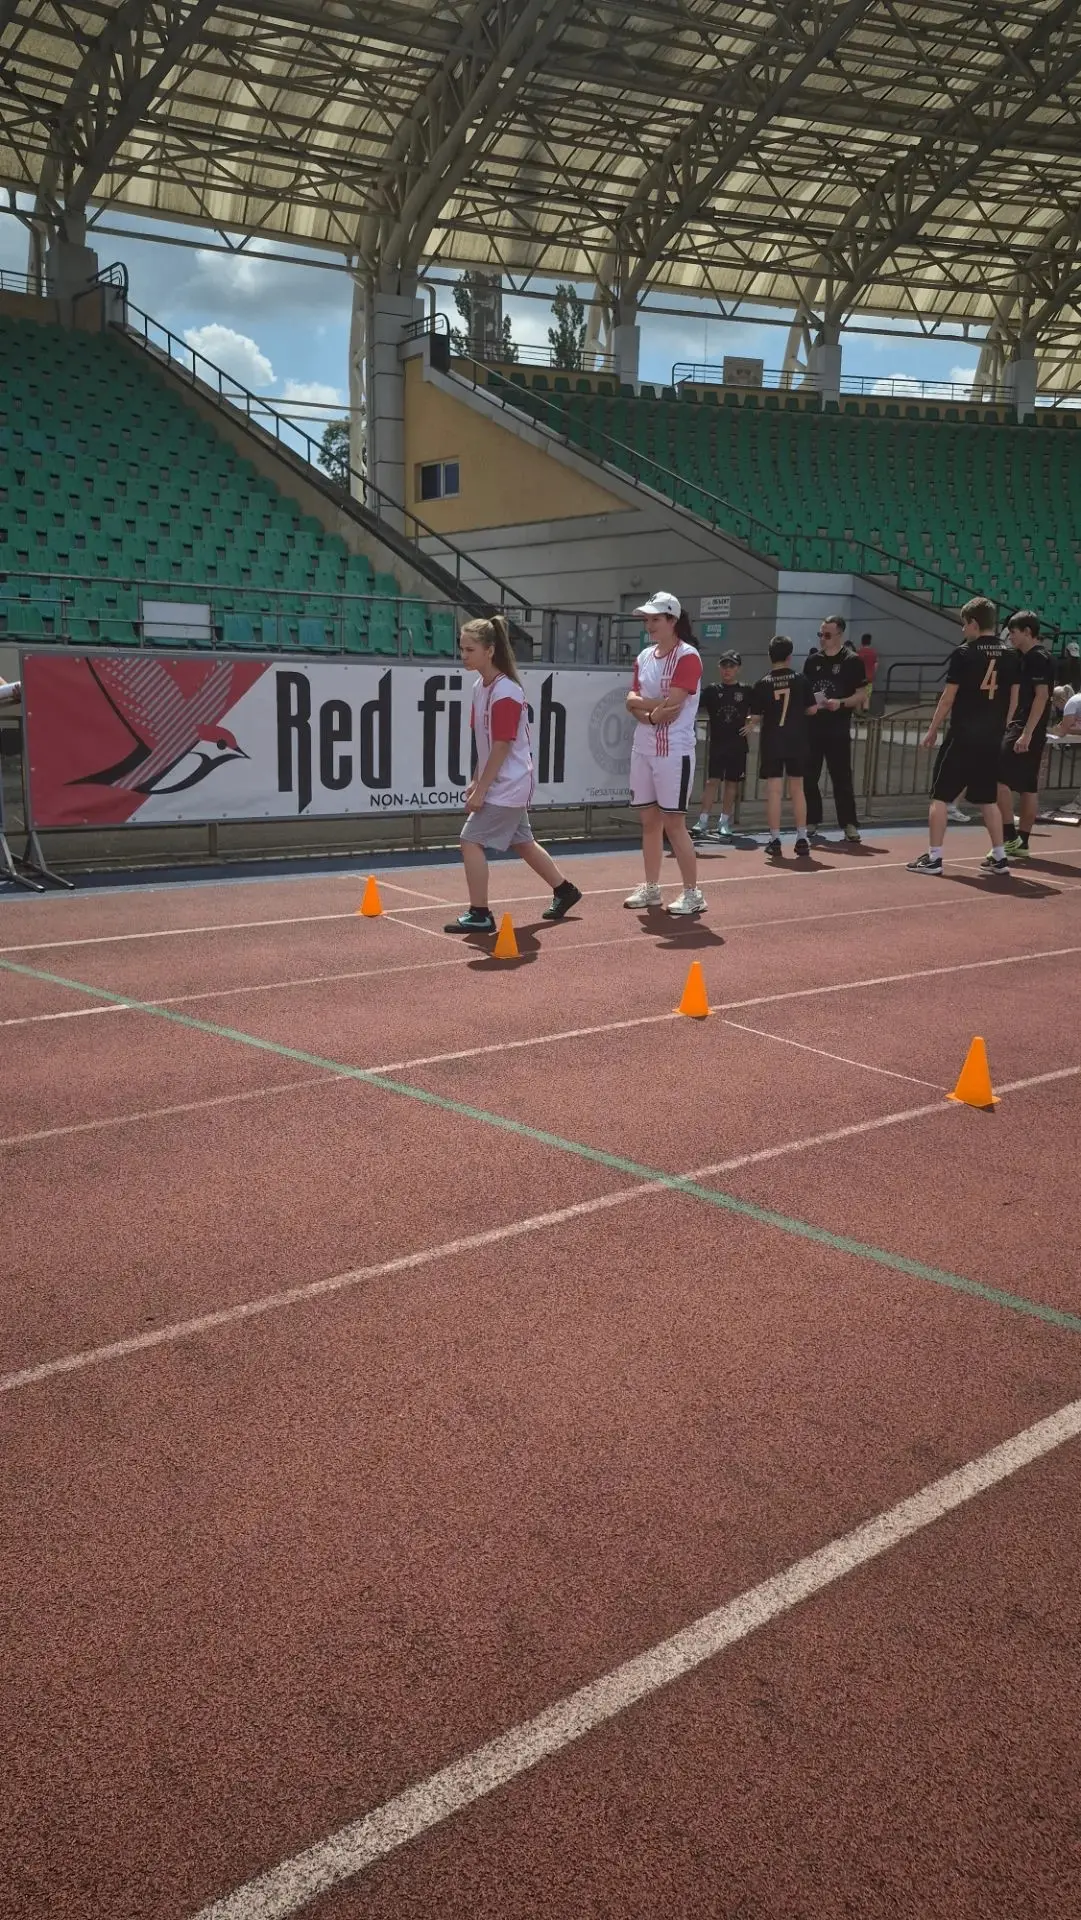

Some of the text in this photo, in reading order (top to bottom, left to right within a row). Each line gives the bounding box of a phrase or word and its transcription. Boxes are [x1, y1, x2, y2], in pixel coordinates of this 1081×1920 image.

[980, 658, 998, 700] 4
[773, 687, 790, 727] 7
[276, 669, 566, 814] Red fih
[370, 791, 467, 806] NON-ALCOHO
